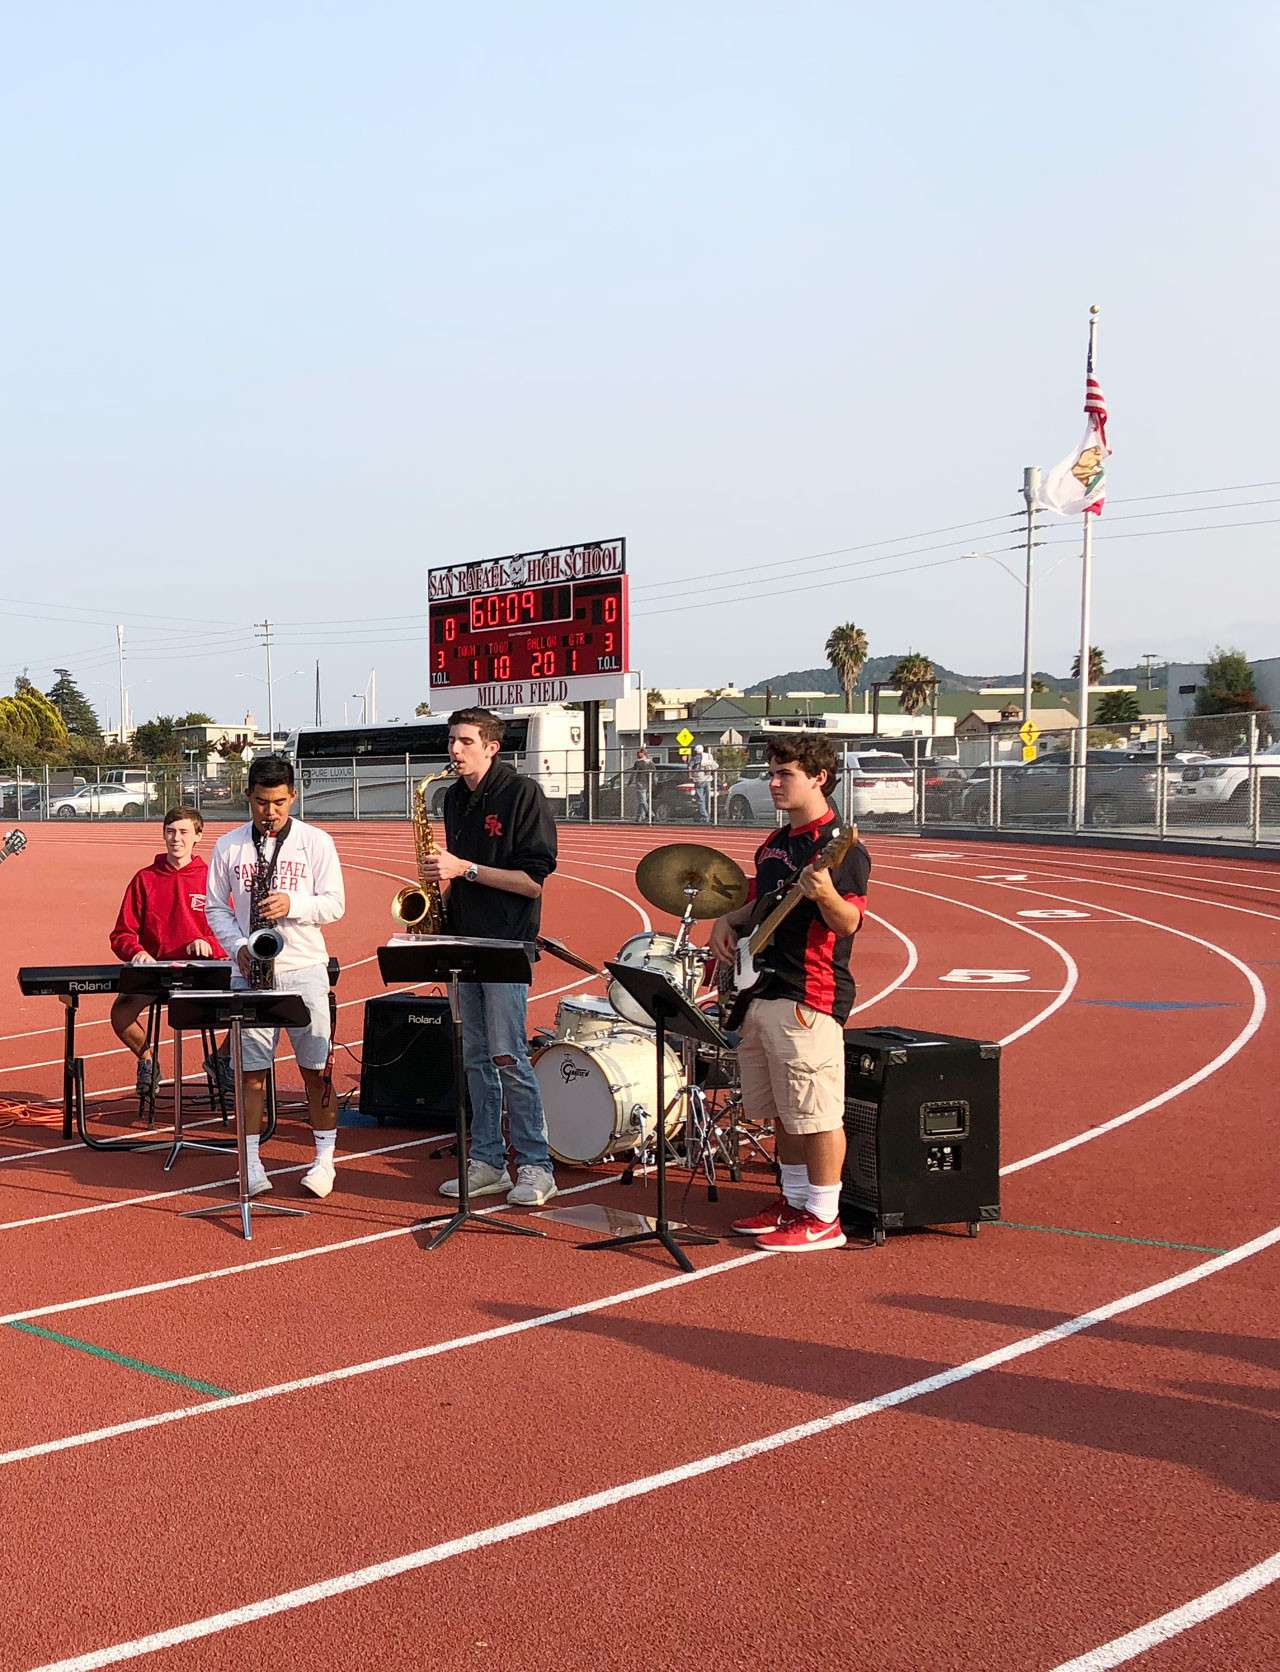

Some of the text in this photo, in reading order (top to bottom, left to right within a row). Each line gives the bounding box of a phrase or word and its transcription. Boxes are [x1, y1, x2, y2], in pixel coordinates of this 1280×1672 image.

[429, 546, 621, 599] SAN RAFAEL HIGH SCHOOL
[605, 597, 617, 623] 0
[445, 618, 455, 641] 0
[604, 632, 613, 652] 3
[438, 650, 445, 669] 3
[494, 655, 510, 679] 10
[531, 651, 555, 677] 20
[477, 680, 568, 707] MILLER FIELD
[311, 768, 328, 778] PURE
[234, 860, 308, 881] SAN AFAEL
[244, 876, 298, 893] SCER
[1016, 909, 1092, 918] 6
[938, 968, 1031, 983] 5
[70, 981, 112, 992] Roland
[408, 1014, 442, 1025] Roland
